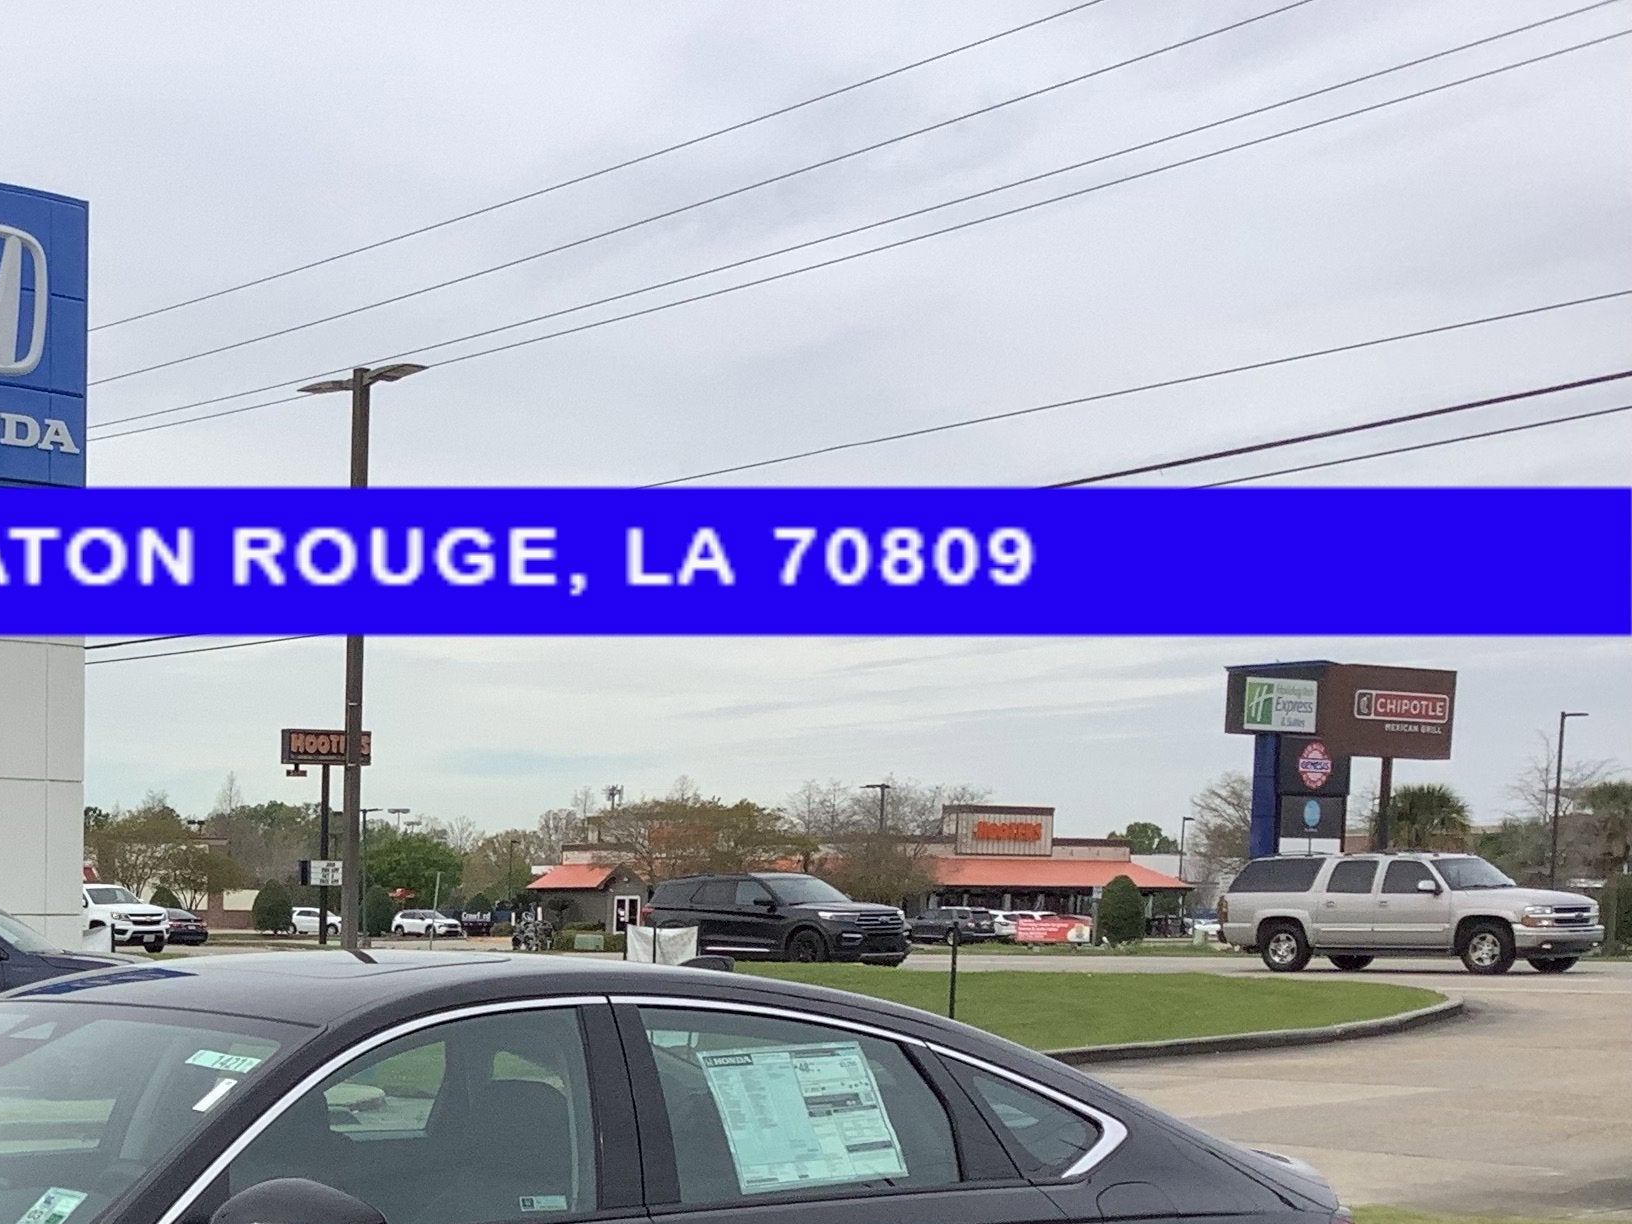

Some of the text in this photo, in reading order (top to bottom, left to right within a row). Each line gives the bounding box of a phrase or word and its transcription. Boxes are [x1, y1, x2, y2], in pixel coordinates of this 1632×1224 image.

[1275, 696, 1313, 715] Express
[1376, 698, 1444, 716] CHIPOTLE
[1384, 723, 1420, 733] MEXICAN
[712, 1055, 752, 1067] HONDA
